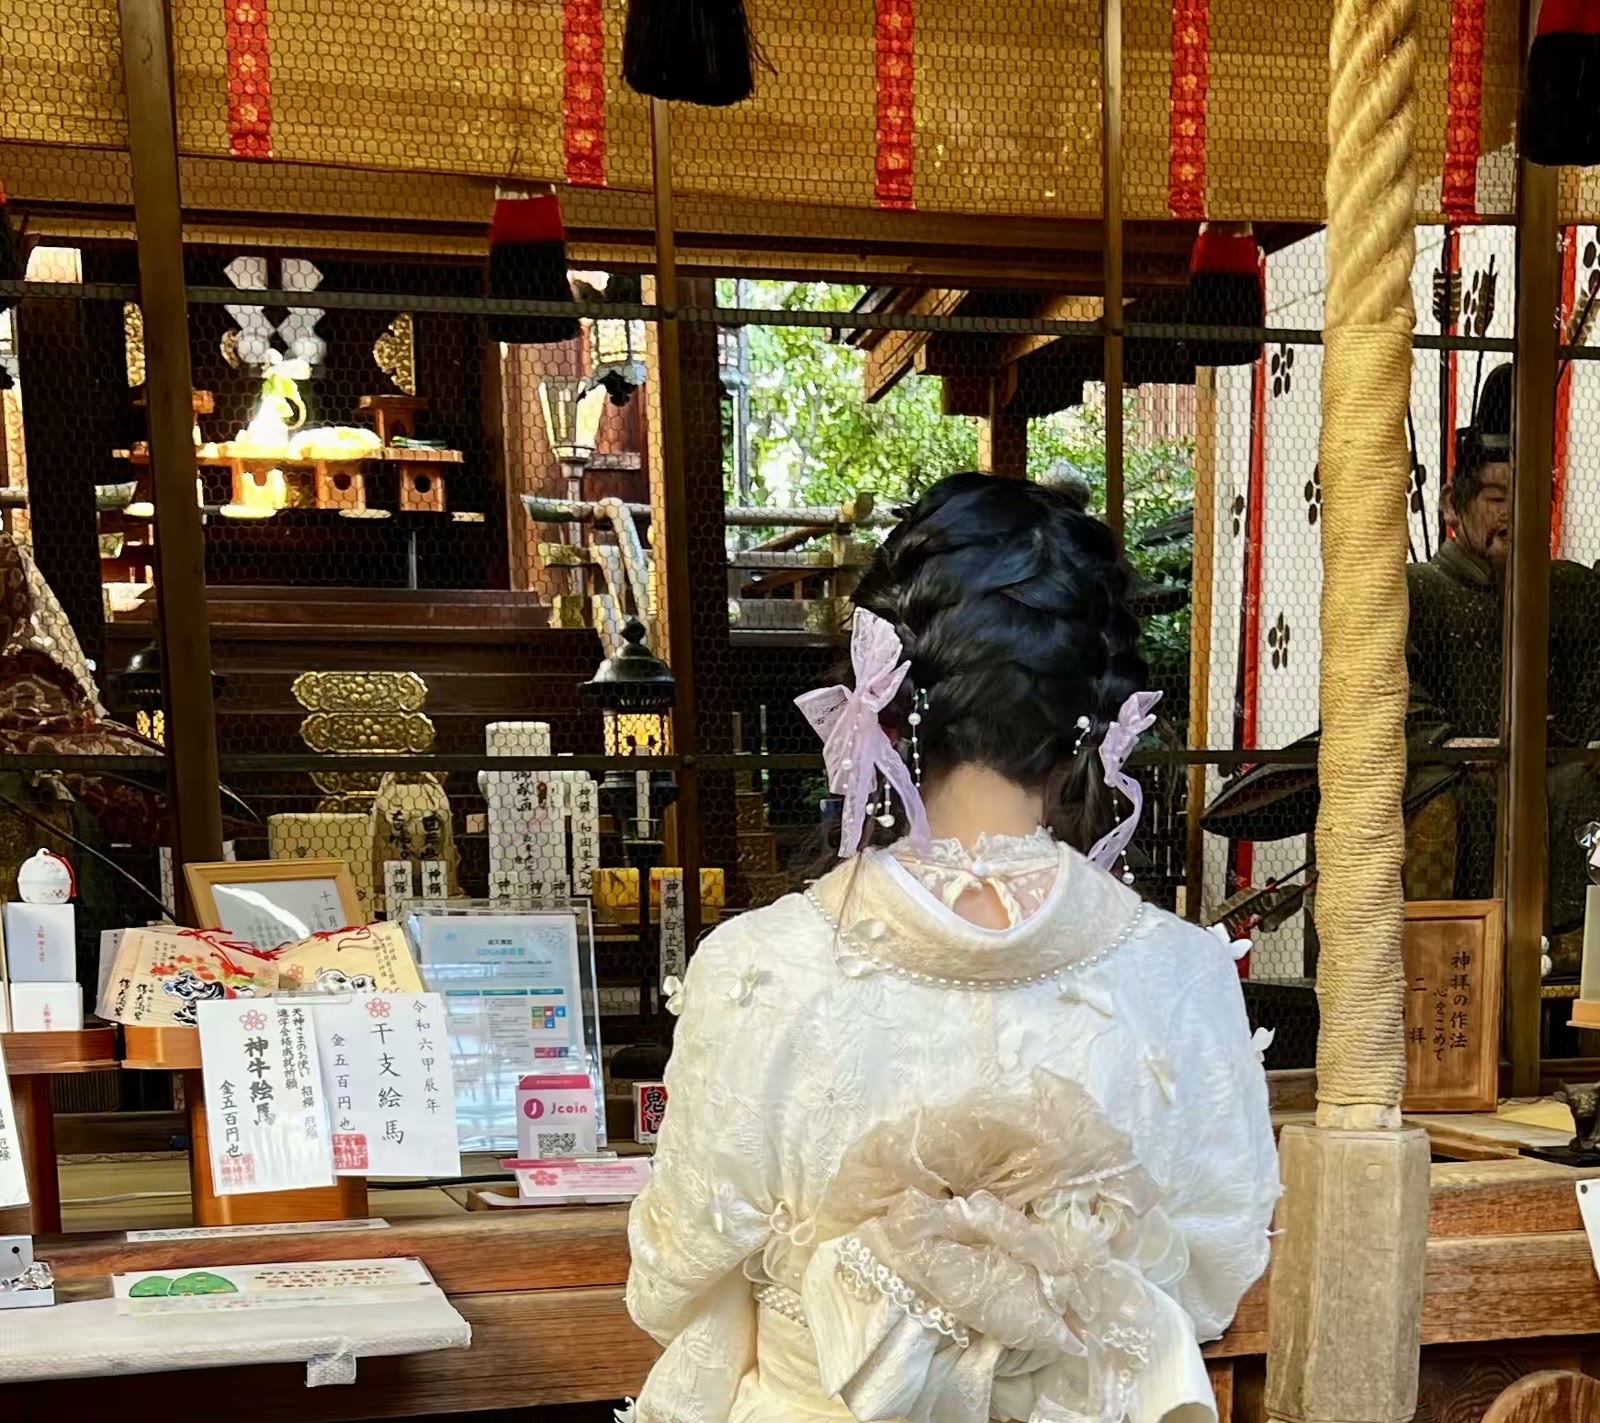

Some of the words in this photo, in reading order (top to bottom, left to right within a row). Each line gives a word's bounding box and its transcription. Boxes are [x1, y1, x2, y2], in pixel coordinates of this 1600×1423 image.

[1433, 988, 1448, 1061] 心をこめて
[1450, 951, 1471, 1049] 神拝の作法
[243, 1036, 277, 1126] 神牛絵馬
[330, 1033, 355, 1131] 金五百円也
[370, 1022, 405, 1145] 干支絵馬
[412, 1000, 440, 1114] 令和六甲辰年
[218, 1079, 243, 1158] 金五百円也
